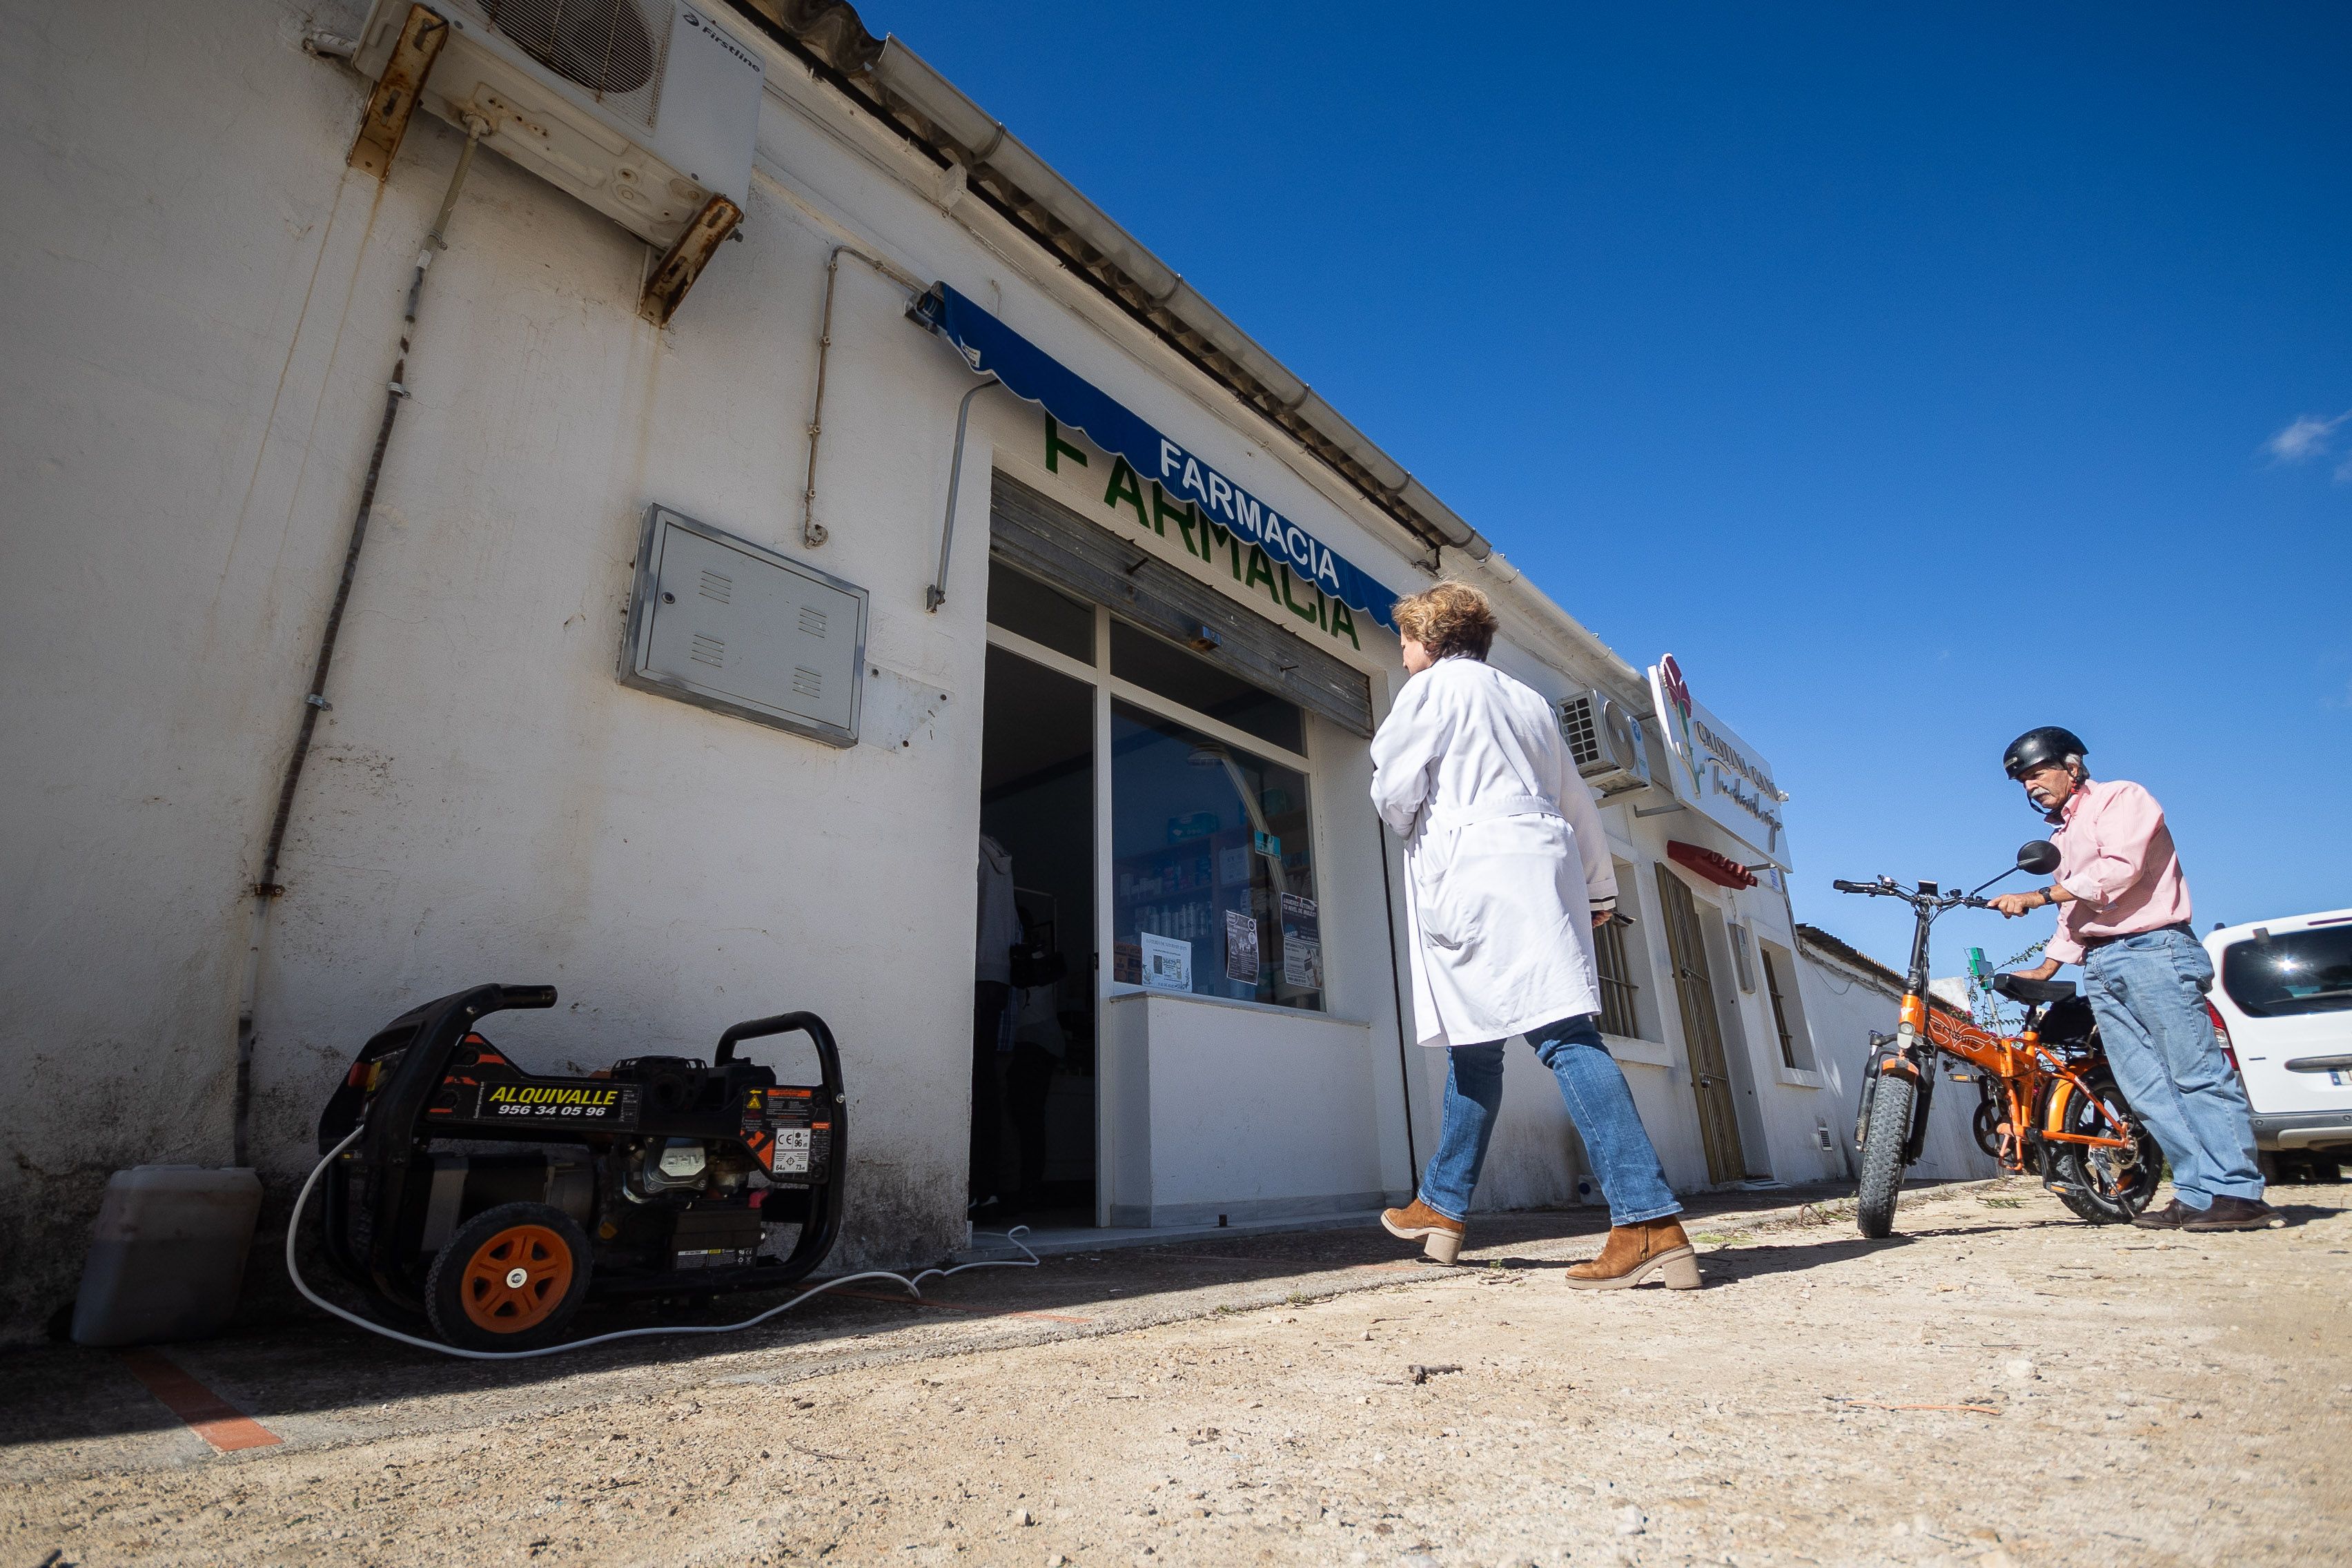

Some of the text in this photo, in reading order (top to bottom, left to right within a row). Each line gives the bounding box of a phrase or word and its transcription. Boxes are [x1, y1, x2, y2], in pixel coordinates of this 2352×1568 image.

[702, 26, 761, 73] Firstline
[1044, 412, 1361, 651] FARMACIA
[1160, 438, 1340, 589] FARMACIA
[1694, 721, 1750, 780] CRISTINA
[489, 1086, 618, 1105] ALQUIVALLE
[498, 1105, 606, 1117] 956 34 05 96
[794, 1139, 803, 1148] 96
